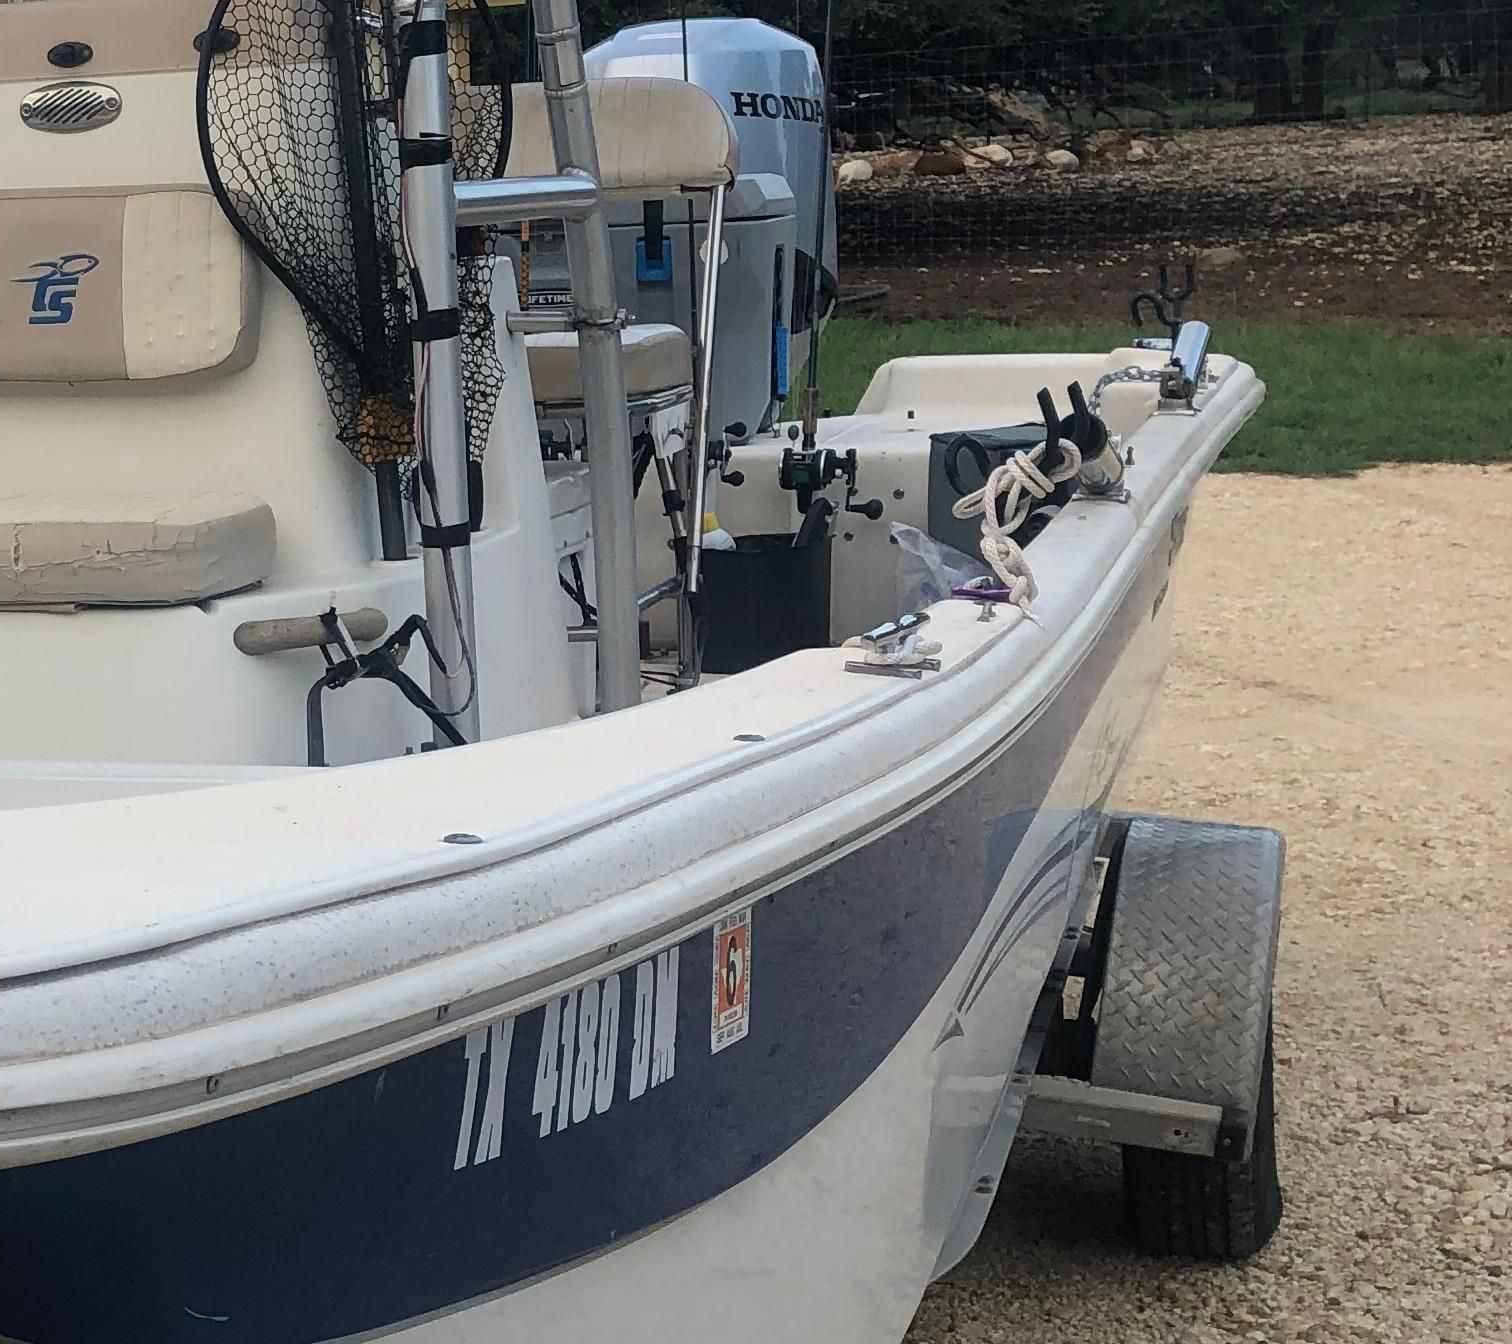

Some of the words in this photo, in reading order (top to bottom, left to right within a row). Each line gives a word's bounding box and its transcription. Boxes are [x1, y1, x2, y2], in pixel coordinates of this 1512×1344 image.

[730, 91, 825, 124] HONDA
[528, 294, 574, 305] IFETIME
[726, 935, 738, 1006] 6
[453, 1015, 516, 1171] TX
[531, 973, 621, 1139] 4180
